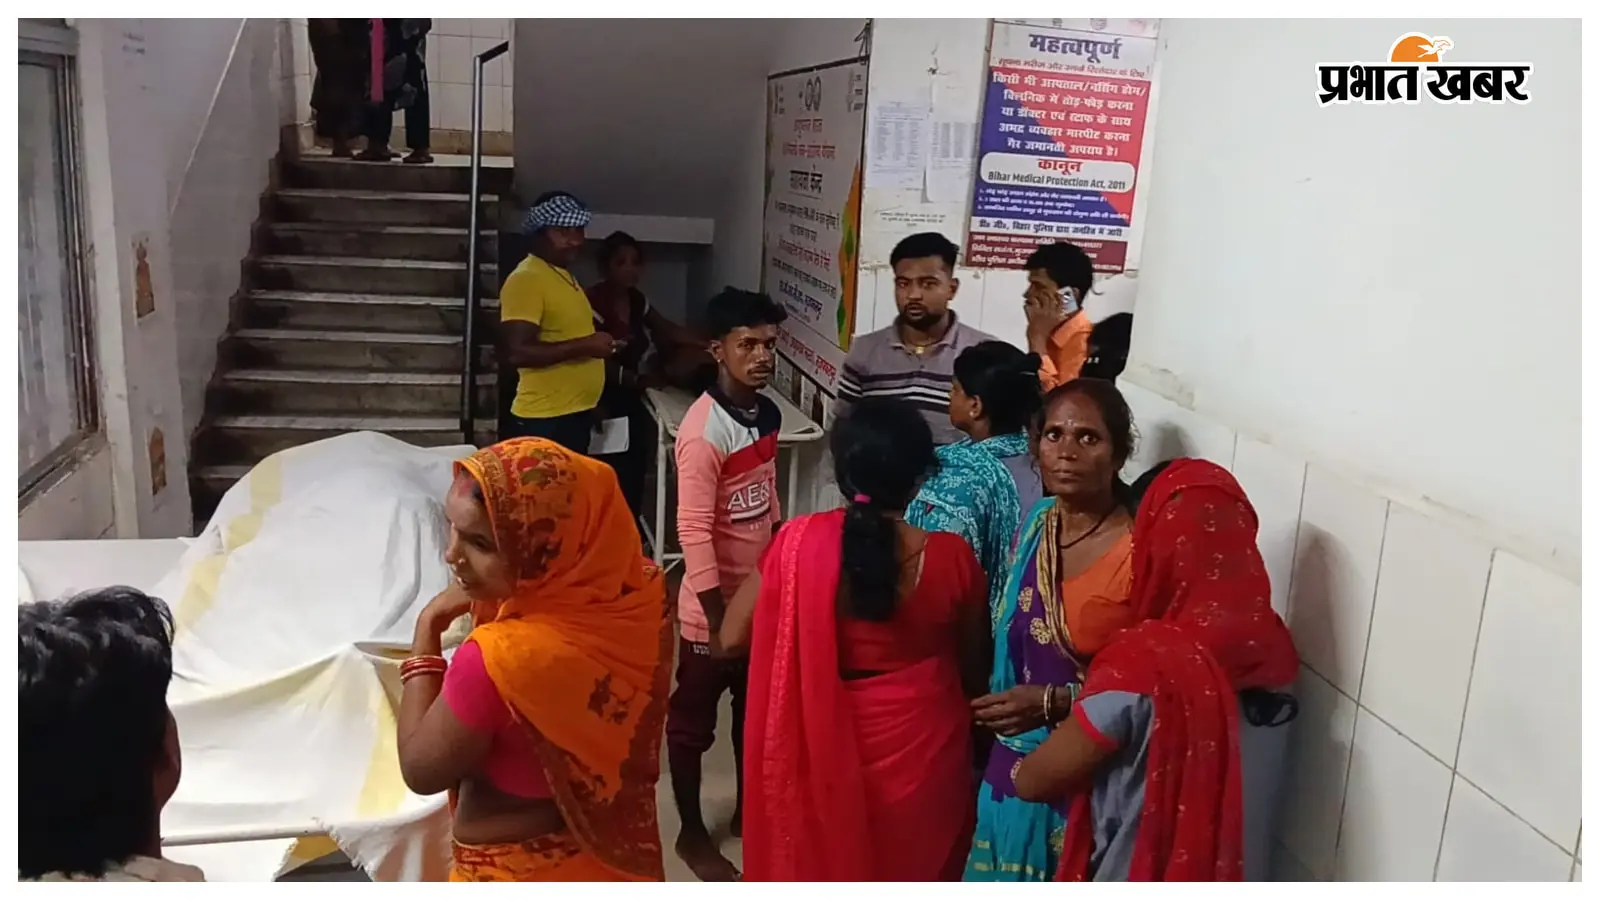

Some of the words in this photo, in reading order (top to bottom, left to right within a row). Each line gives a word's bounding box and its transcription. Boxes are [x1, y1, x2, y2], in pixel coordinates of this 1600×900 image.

[1028, 34, 1122, 63] महत्वपूर्ण
[993, 71, 1020, 84] किसी
[1024, 74, 1038, 87] भी
[1004, 88, 1045, 103] क्लिनिक
[1049, 92, 1060, 105] में
[1107, 100, 1134, 111] करना
[1001, 106, 1015, 117] या
[1017, 106, 1048, 120] डॉक्टर
[1050, 110, 1066, 121] एवं
[1070, 112, 1094, 123] स्टाफ
[1096, 112, 1108, 125] के
[1111, 116, 1132, 127] साथ
[998, 122, 1025, 133] अभद्र
[1028, 125, 1063, 137] व्यवहार
[1066, 128, 1101, 140] मारपीट
[1104, 131, 1132, 142] करना
[1007, 137, 1021, 149] गैर
[1024, 140, 1066, 153] जमानती
[1069, 145, 1104, 156] अपराध
[1106, 144, 1119, 157] है।
[1037, 158, 1084, 176] कानून
[988, 170, 1011, 181] Bihar
[1013, 172, 1045, 184] Medical
[1046, 175, 1089, 187] Protection
[1090, 179, 1106, 189] Act,
[1107, 180, 1126, 190] 2011
[1012, 220, 1031, 231] बिहार
[1033, 222, 1054, 234] पुलिस
[1072, 225, 1096, 236] जनहित
[1107, 228, 1123, 238] जारी
